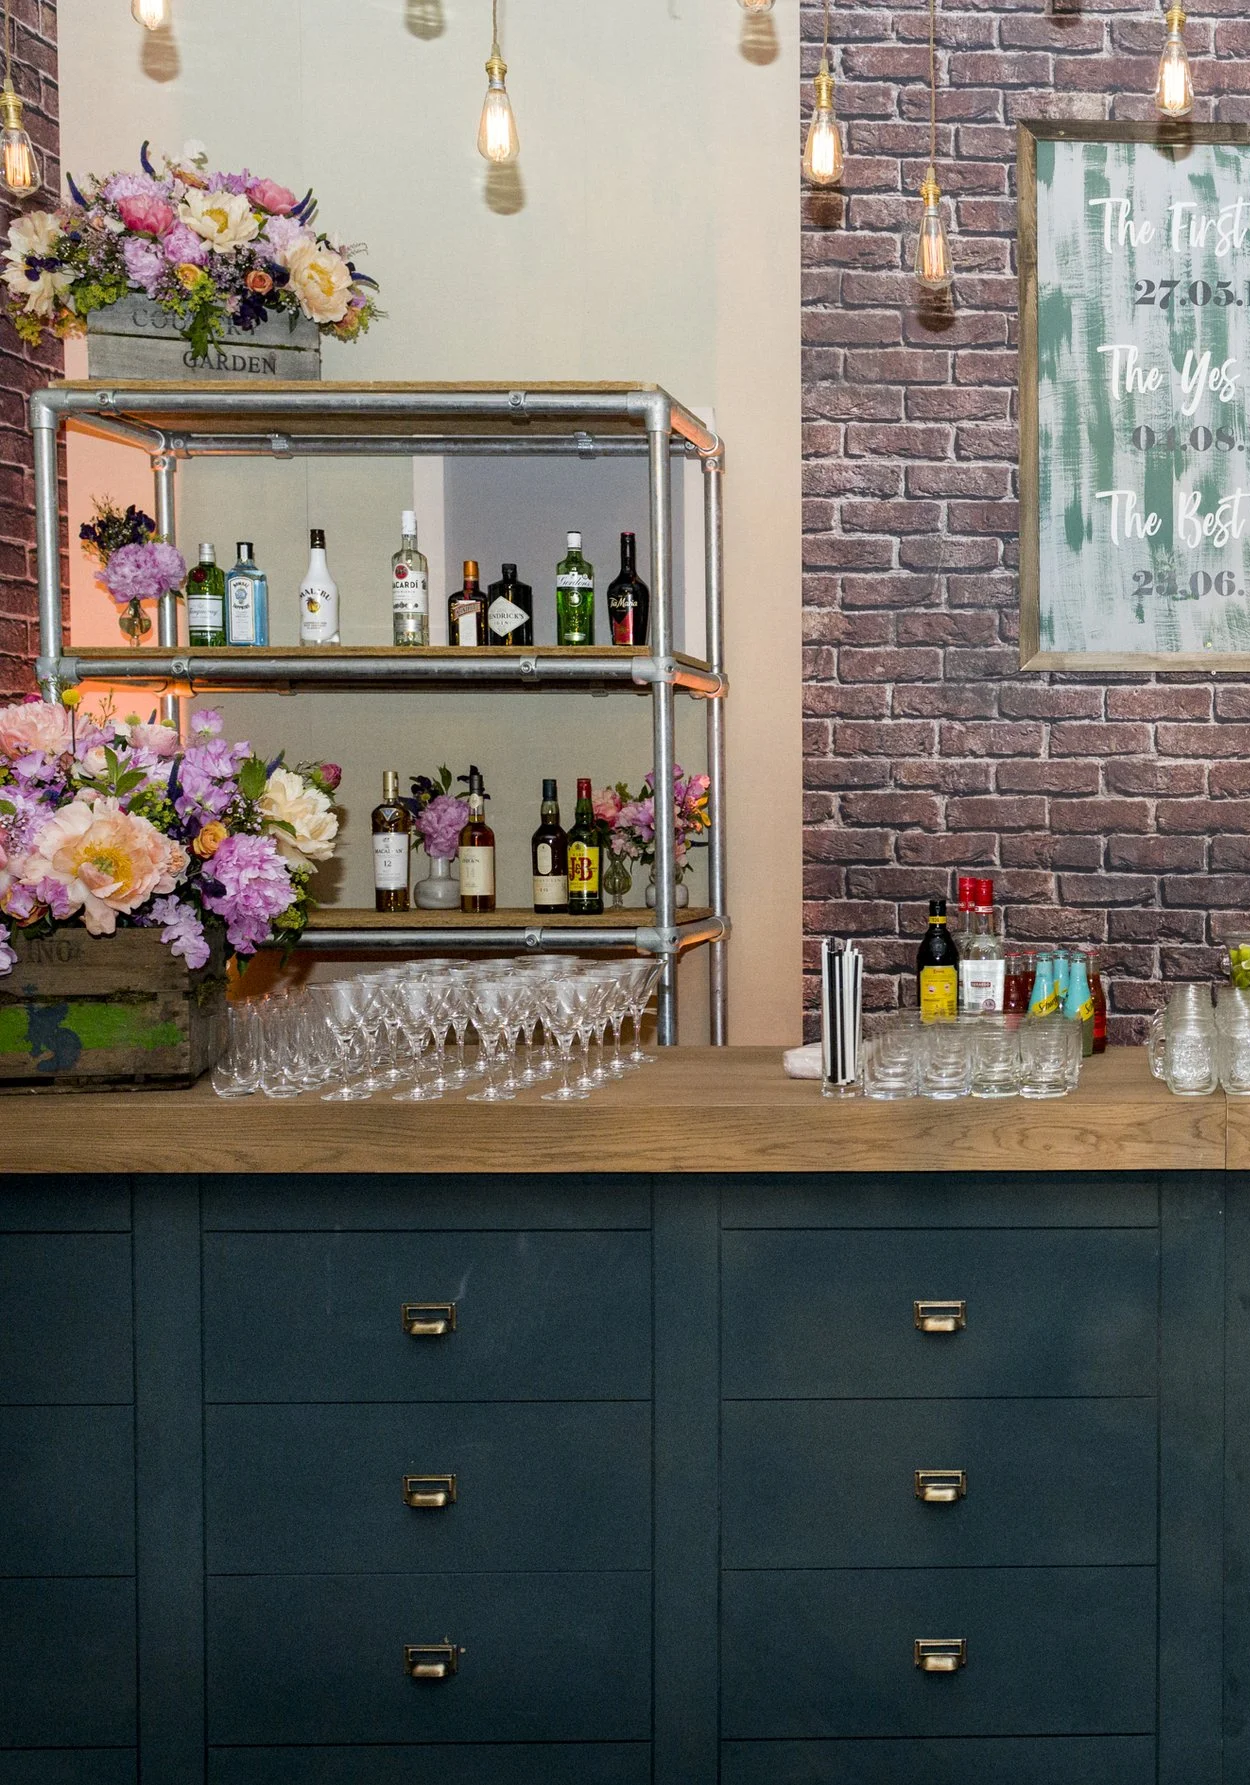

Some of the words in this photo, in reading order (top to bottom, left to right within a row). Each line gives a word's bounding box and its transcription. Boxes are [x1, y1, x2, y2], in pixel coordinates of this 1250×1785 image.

[1088, 197, 1156, 254] The
[183, 350, 277, 375] GARDEN
[1096, 344, 1162, 401] The
[1180, 347, 1240, 416] Yes
[1096, 490, 1162, 547] The
[569, 857, 593, 881] J&B
